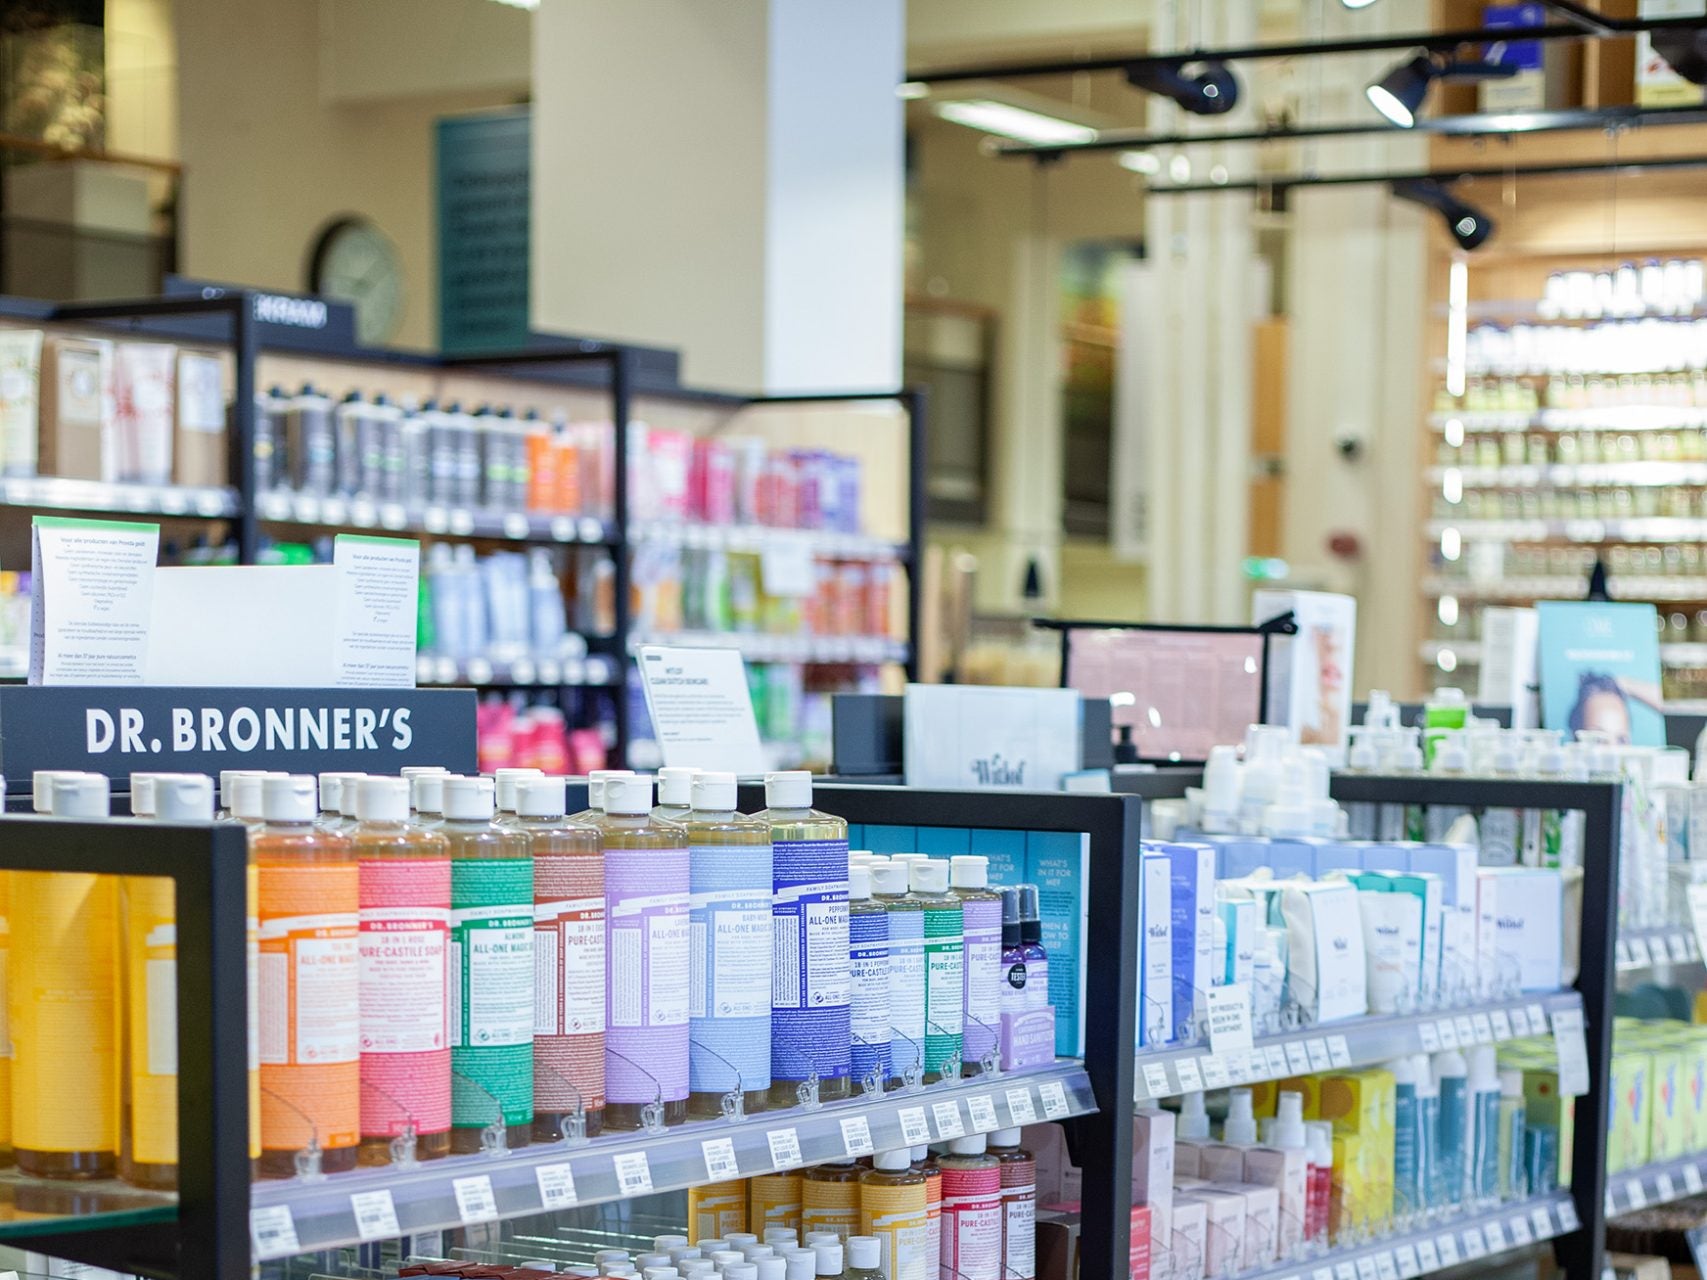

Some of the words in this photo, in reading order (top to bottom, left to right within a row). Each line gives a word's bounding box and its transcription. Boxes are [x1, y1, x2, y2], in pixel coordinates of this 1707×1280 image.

[86, 707, 161, 754] DR.
[173, 706, 413, 752] BRONNER'S
[1039, 859, 1068, 868] WHAT'S
[1055, 869, 1072, 877] FOR
[809, 915, 837, 925] ALL-ONE
[718, 924, 750, 933] ALL-ONE
[473, 943, 509, 954] ALL-ONE
